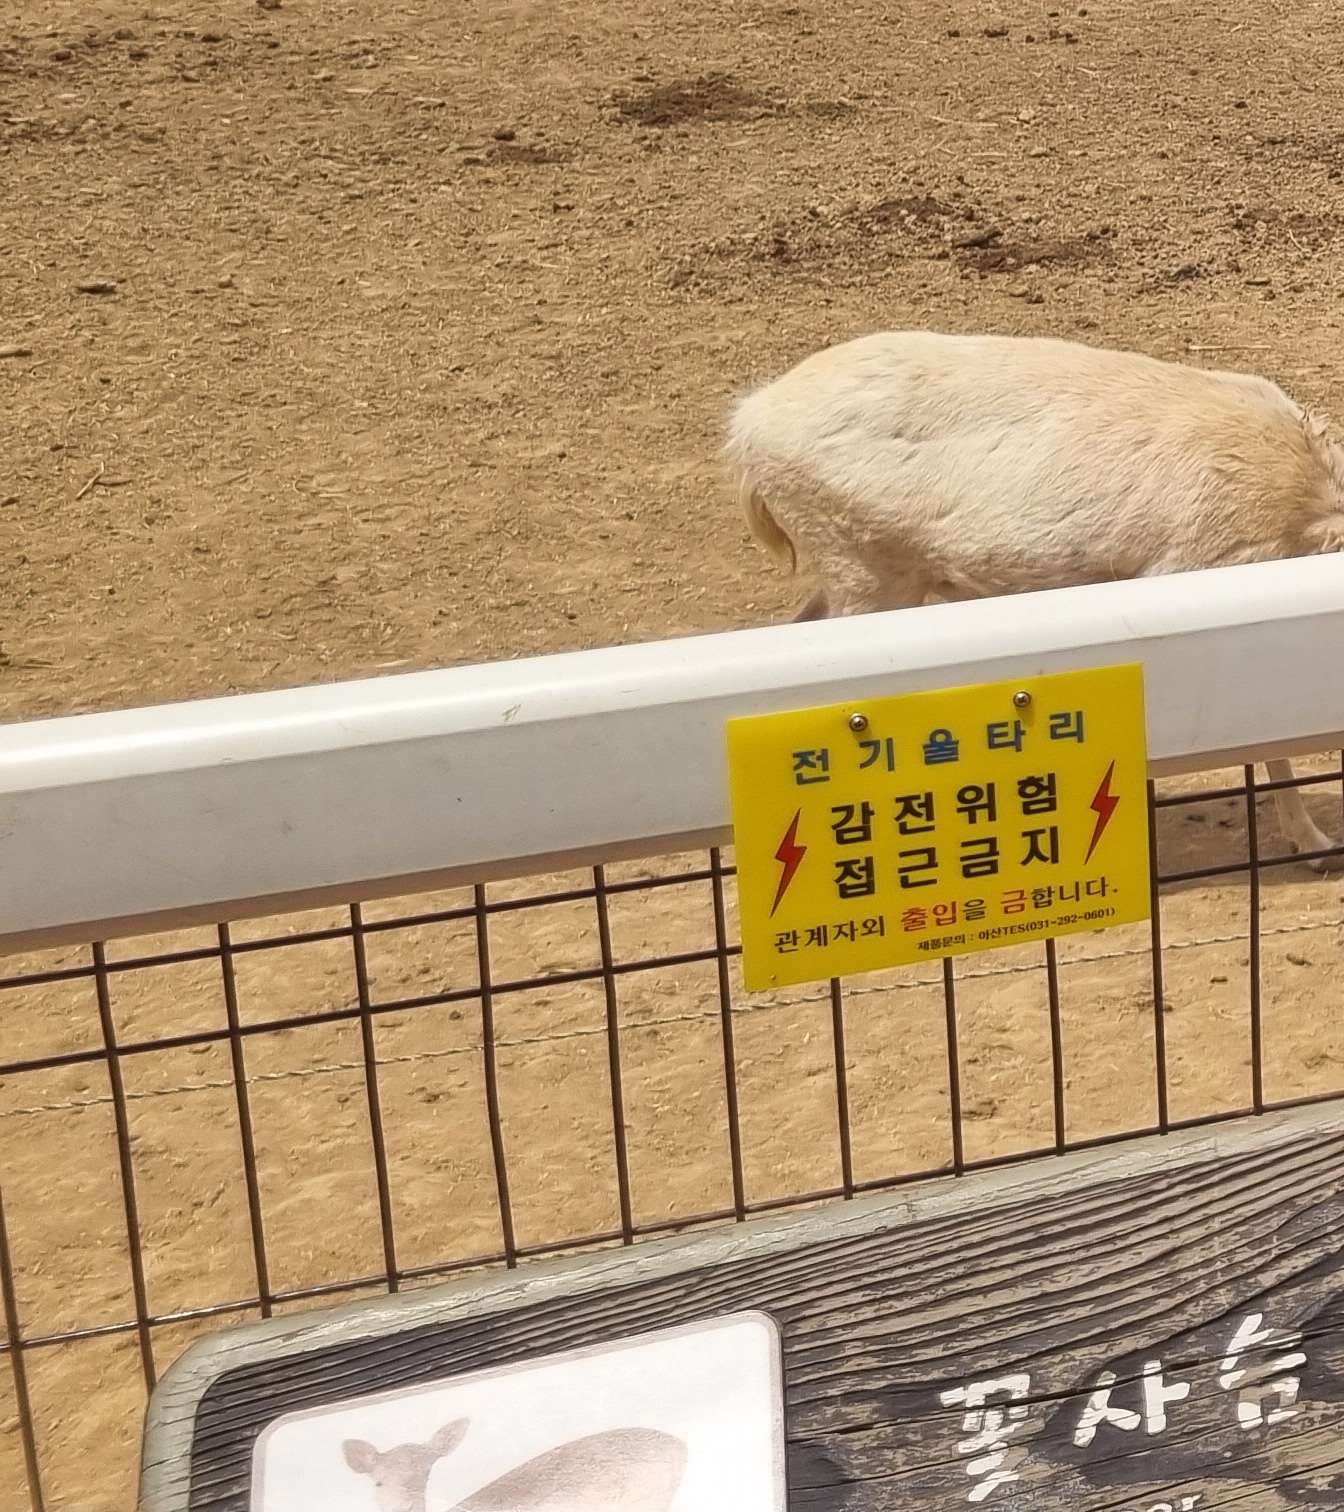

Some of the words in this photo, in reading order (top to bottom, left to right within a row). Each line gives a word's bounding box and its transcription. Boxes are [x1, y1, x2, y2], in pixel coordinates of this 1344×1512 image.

[792, 710, 1086, 786] 전기울타리
[830, 772, 1058, 846] 감전위험
[833, 825, 1060, 899] 접근금지
[773, 915, 886, 954] 관계자외
[899, 897, 988, 933] 출입을
[1000, 875, 1119, 915] 금합니다.
